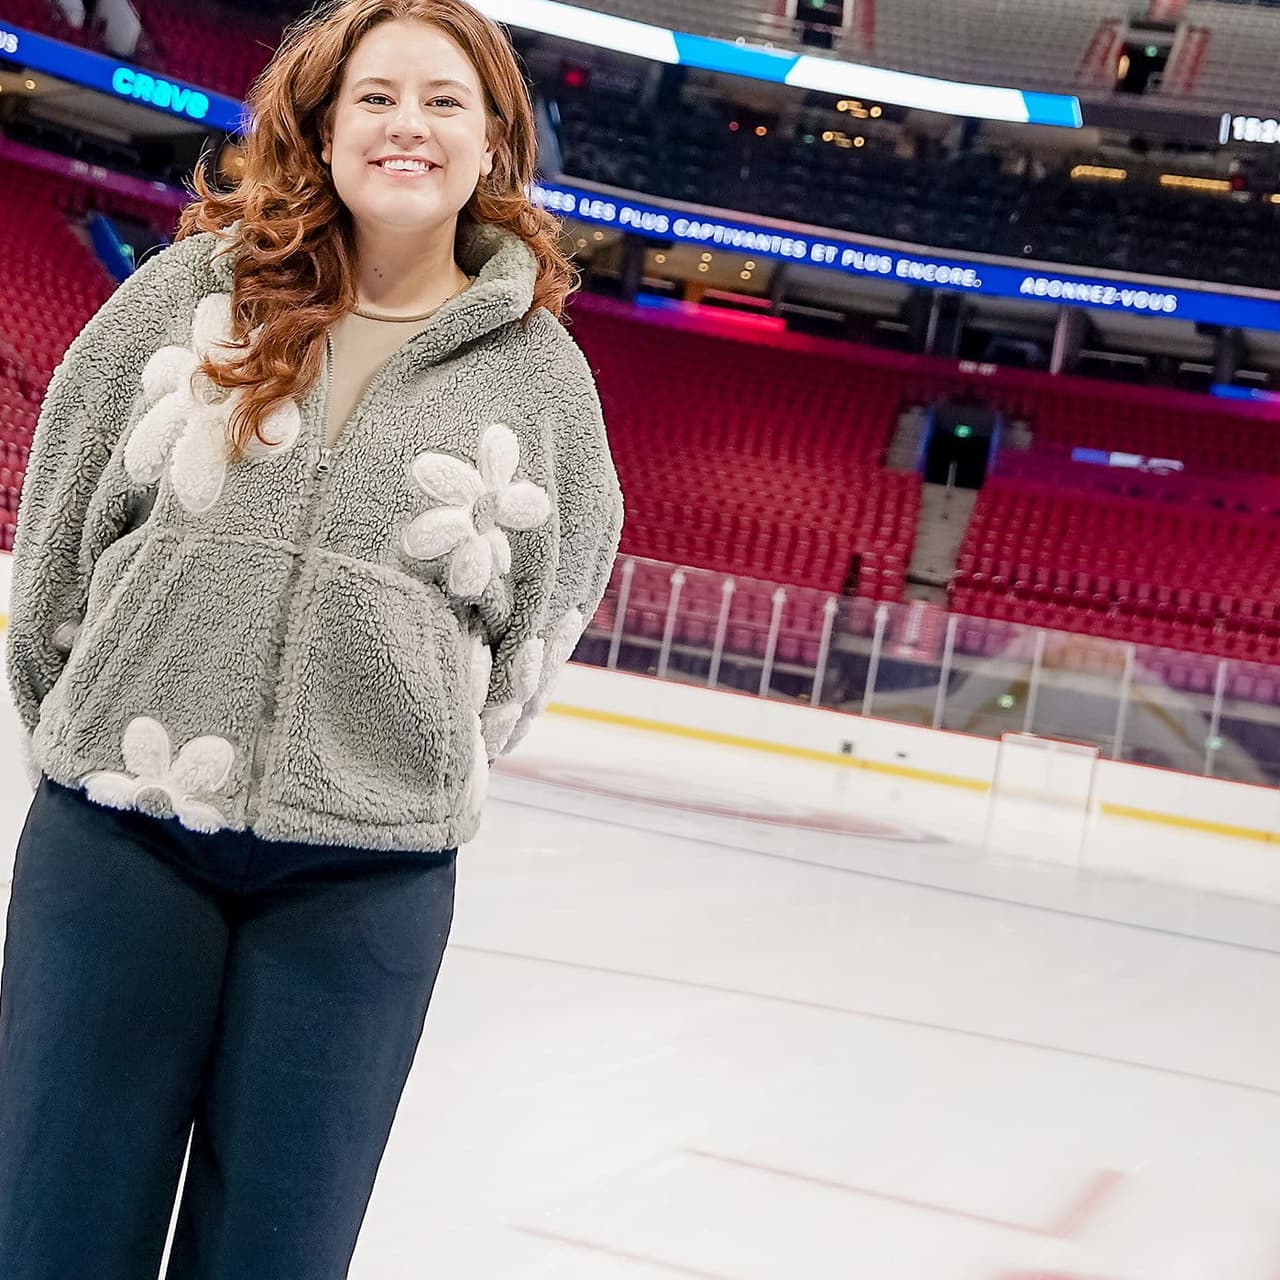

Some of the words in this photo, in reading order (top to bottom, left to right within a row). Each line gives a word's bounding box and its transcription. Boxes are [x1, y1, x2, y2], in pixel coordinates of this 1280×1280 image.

[579, 198, 617, 221] LES
[619, 207, 669, 233] PLUS
[673, 219, 807, 258] CAPTIVANTES
[810, 243, 838, 263] ET
[841, 250, 892, 274] PLUS
[1020, 277, 1178, 313] ABONNEZ-VOUS
